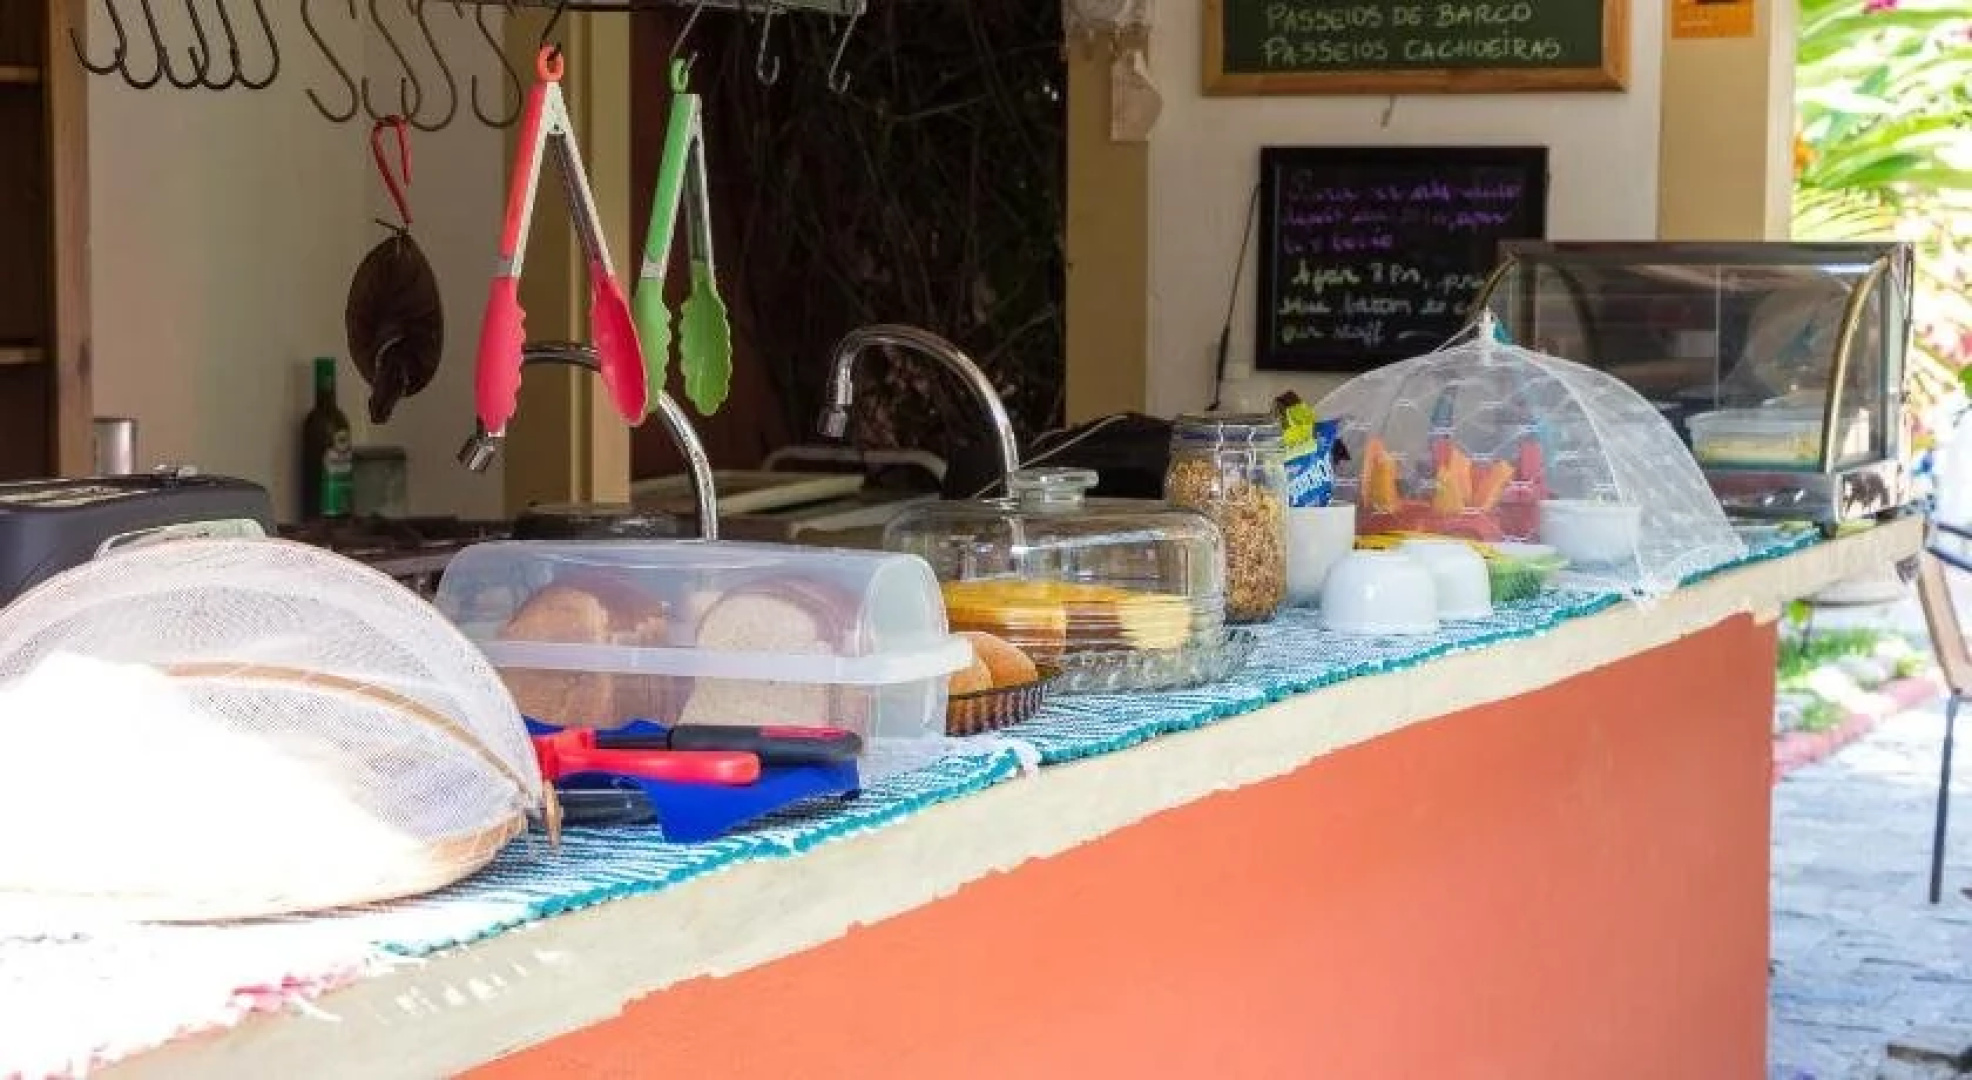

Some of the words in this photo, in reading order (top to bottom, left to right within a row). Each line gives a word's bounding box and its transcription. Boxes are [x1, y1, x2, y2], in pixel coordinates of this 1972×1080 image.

[1267, 2, 1384, 31] PASSEIOS
[1393, 5, 1421, 27] DE
[1435, 3, 1532, 28] BARCO
[1264, 37, 1388, 66] PASSEIOS
